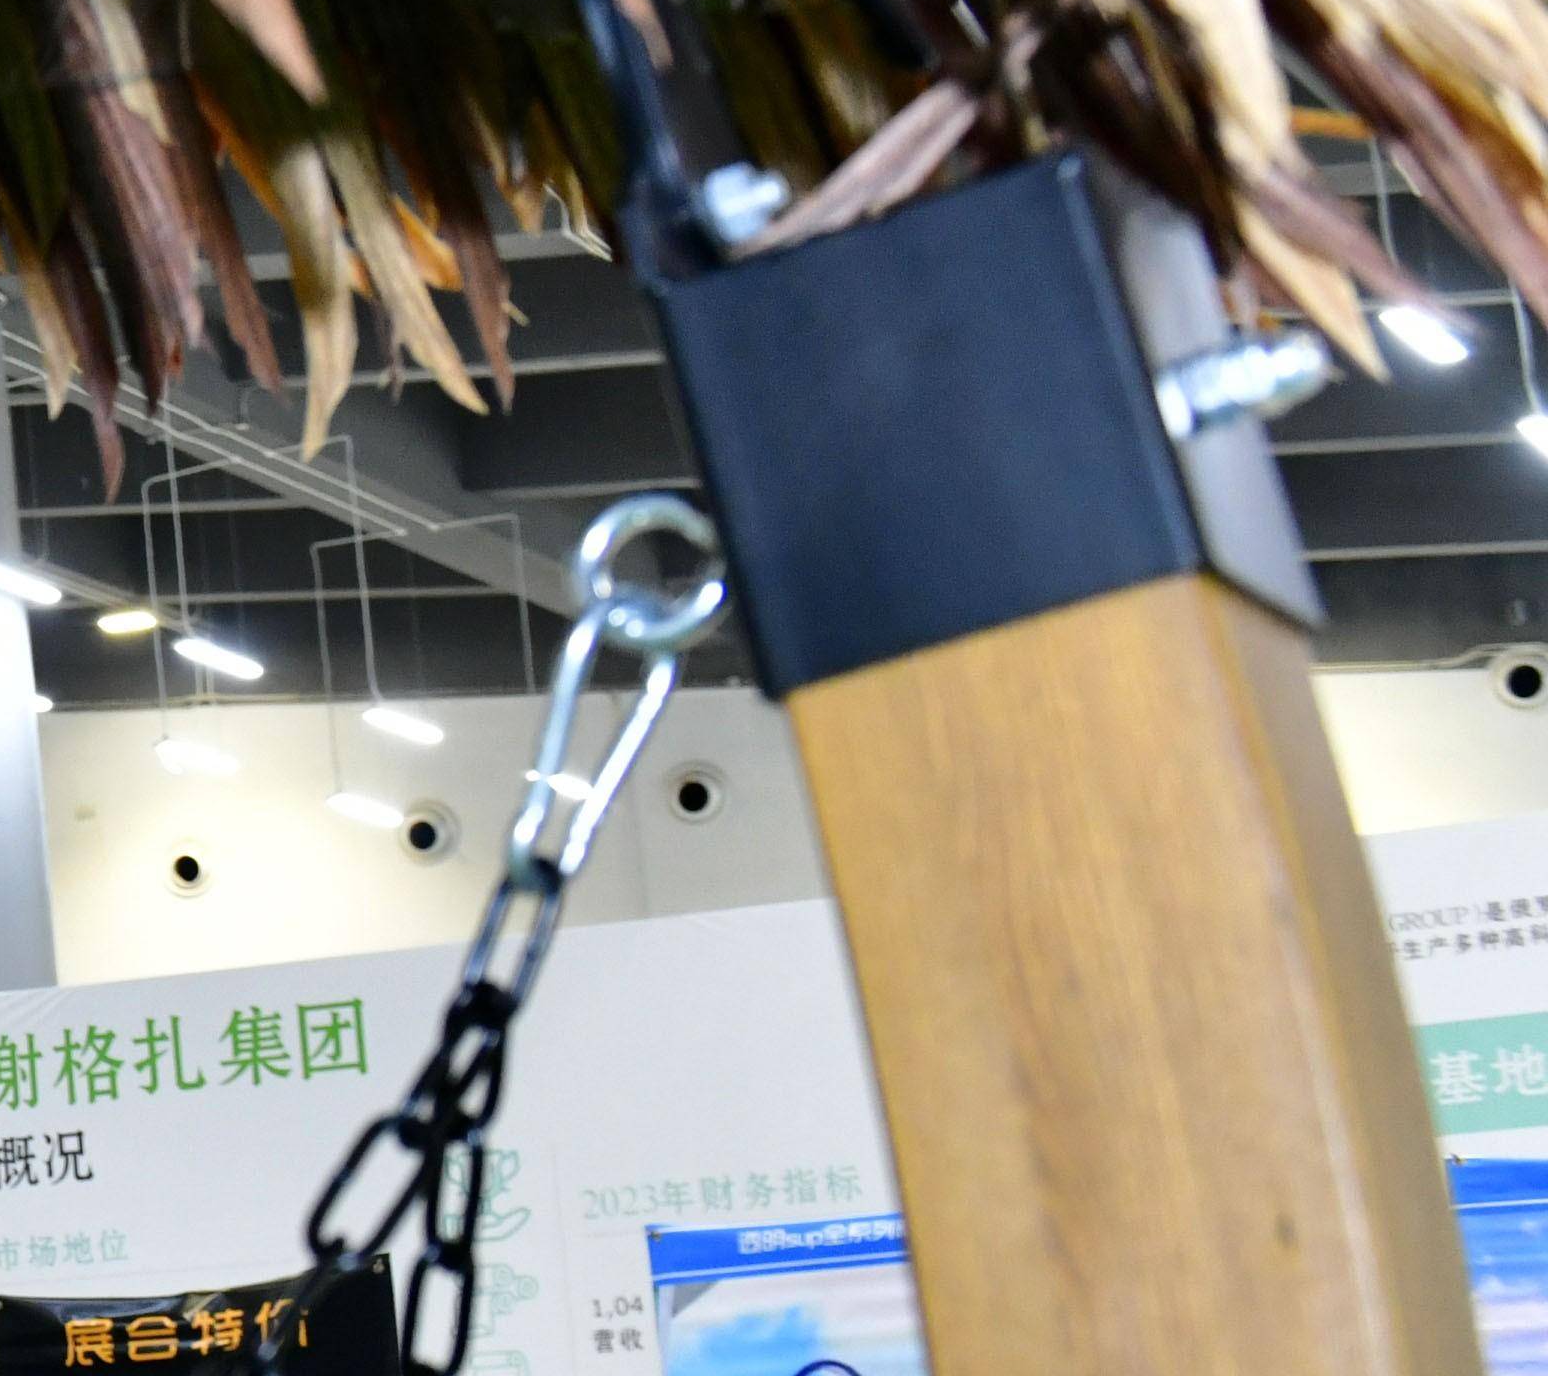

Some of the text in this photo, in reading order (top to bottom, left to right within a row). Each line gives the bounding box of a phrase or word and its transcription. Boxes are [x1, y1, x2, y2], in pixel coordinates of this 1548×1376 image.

[583, 1164, 862, 1220] 2023年财务指标
